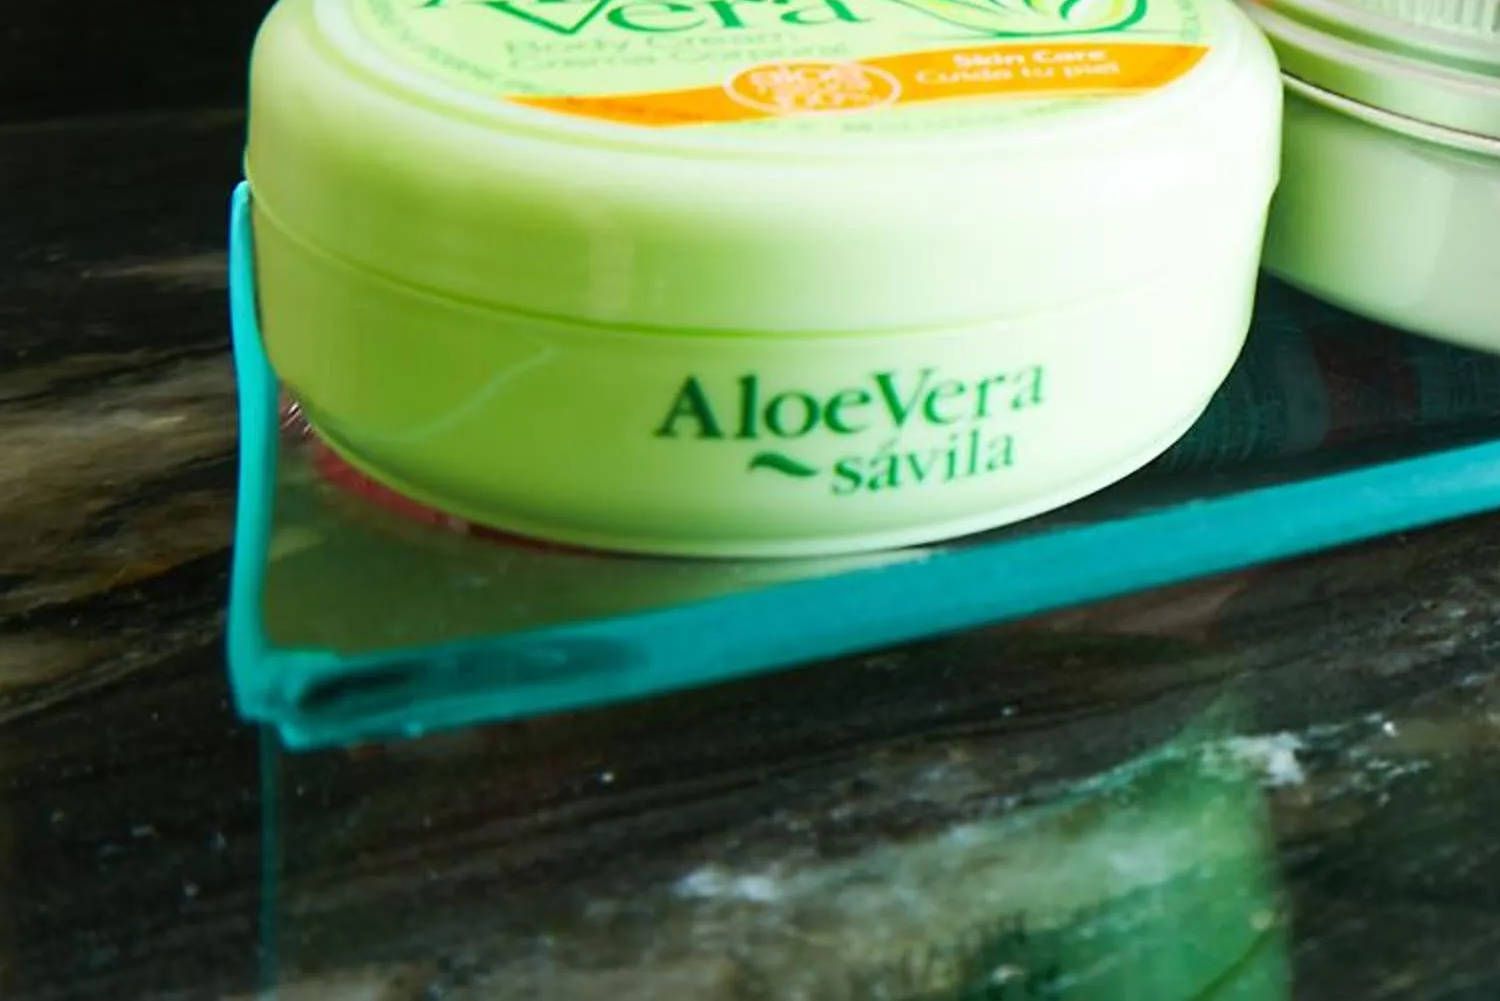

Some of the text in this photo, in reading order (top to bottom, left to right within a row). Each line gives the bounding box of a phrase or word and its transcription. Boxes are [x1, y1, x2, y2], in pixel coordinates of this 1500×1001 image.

[953, 49, 1108, 68] Skin Care
[830, 428, 1015, 497] sávila
